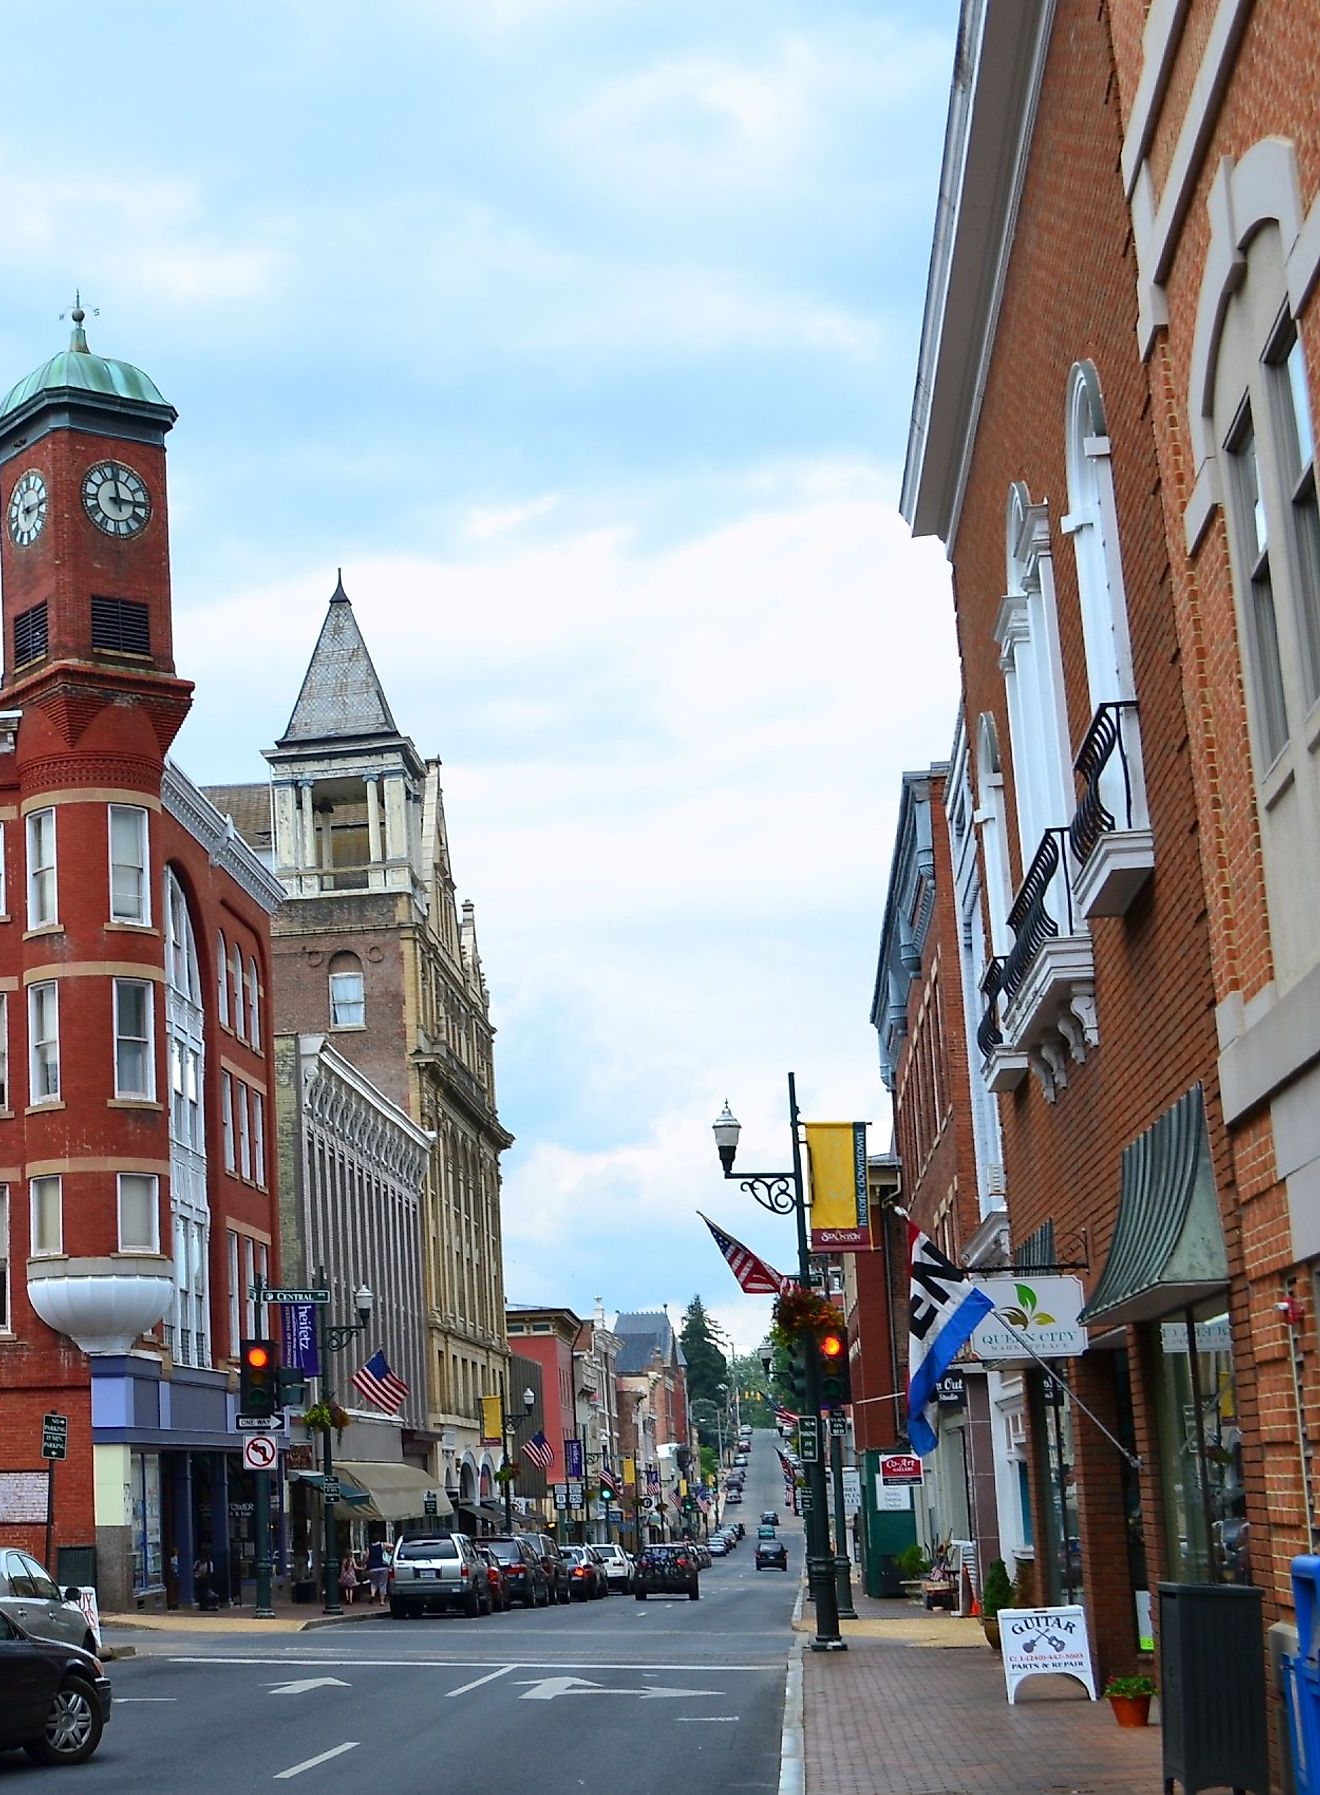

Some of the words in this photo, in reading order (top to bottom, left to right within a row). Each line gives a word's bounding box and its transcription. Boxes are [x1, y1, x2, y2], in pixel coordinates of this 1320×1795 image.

[856, 1132, 867, 1185] downtown
[857, 1189, 868, 1226] historic
[277, 1292, 313, 1301] CENTRAL
[298, 1304, 312, 1350] heifetz
[1040, 1331, 1077, 1342] CITY
[944, 1377, 964, 1390] Out
[886, 1458, 915, 1468] Co-Art
[1011, 1616, 1076, 1635] GUITAR
[1012, 1662, 1039, 1670] PARTS
